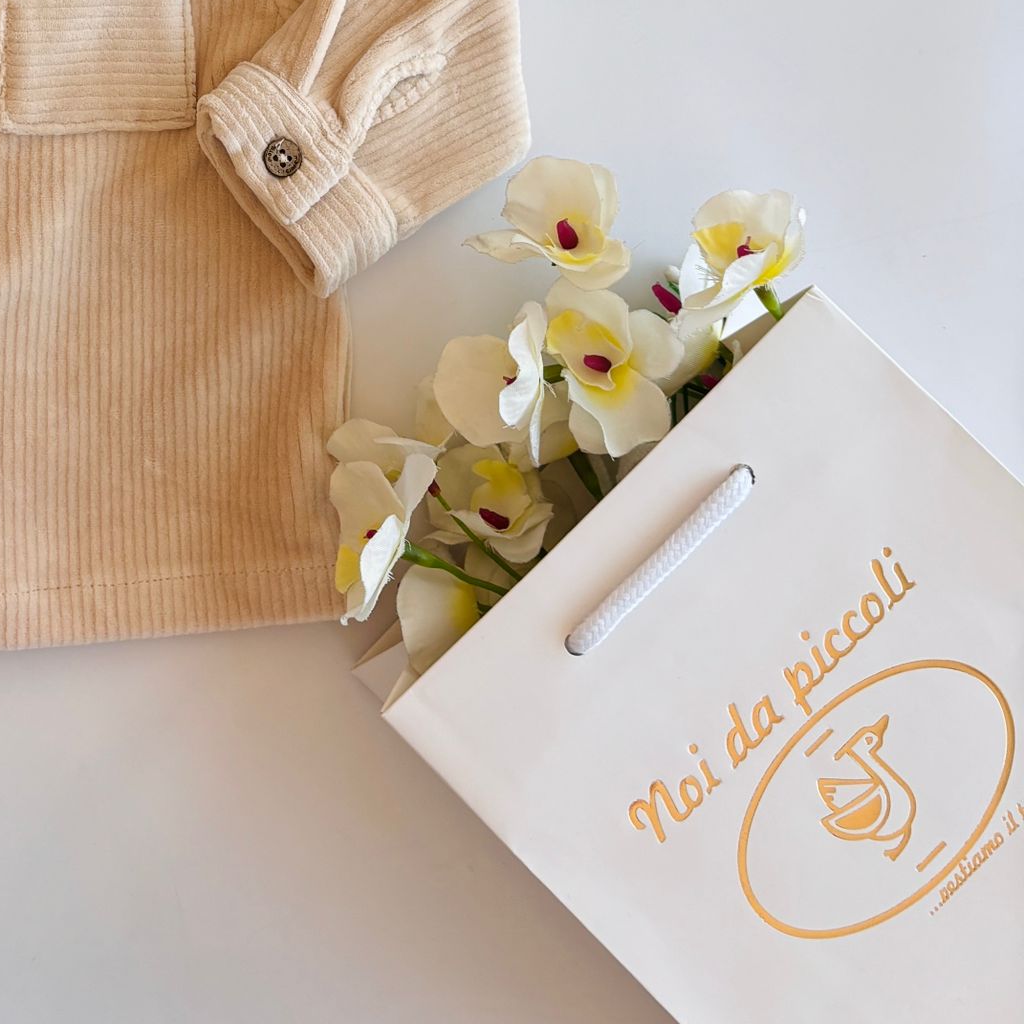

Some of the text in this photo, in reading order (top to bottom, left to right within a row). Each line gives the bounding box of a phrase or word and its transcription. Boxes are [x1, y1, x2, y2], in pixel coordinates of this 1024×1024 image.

[628, 546, 917, 844] Noi da piccoli
[1001, 809, 1020, 836] il
